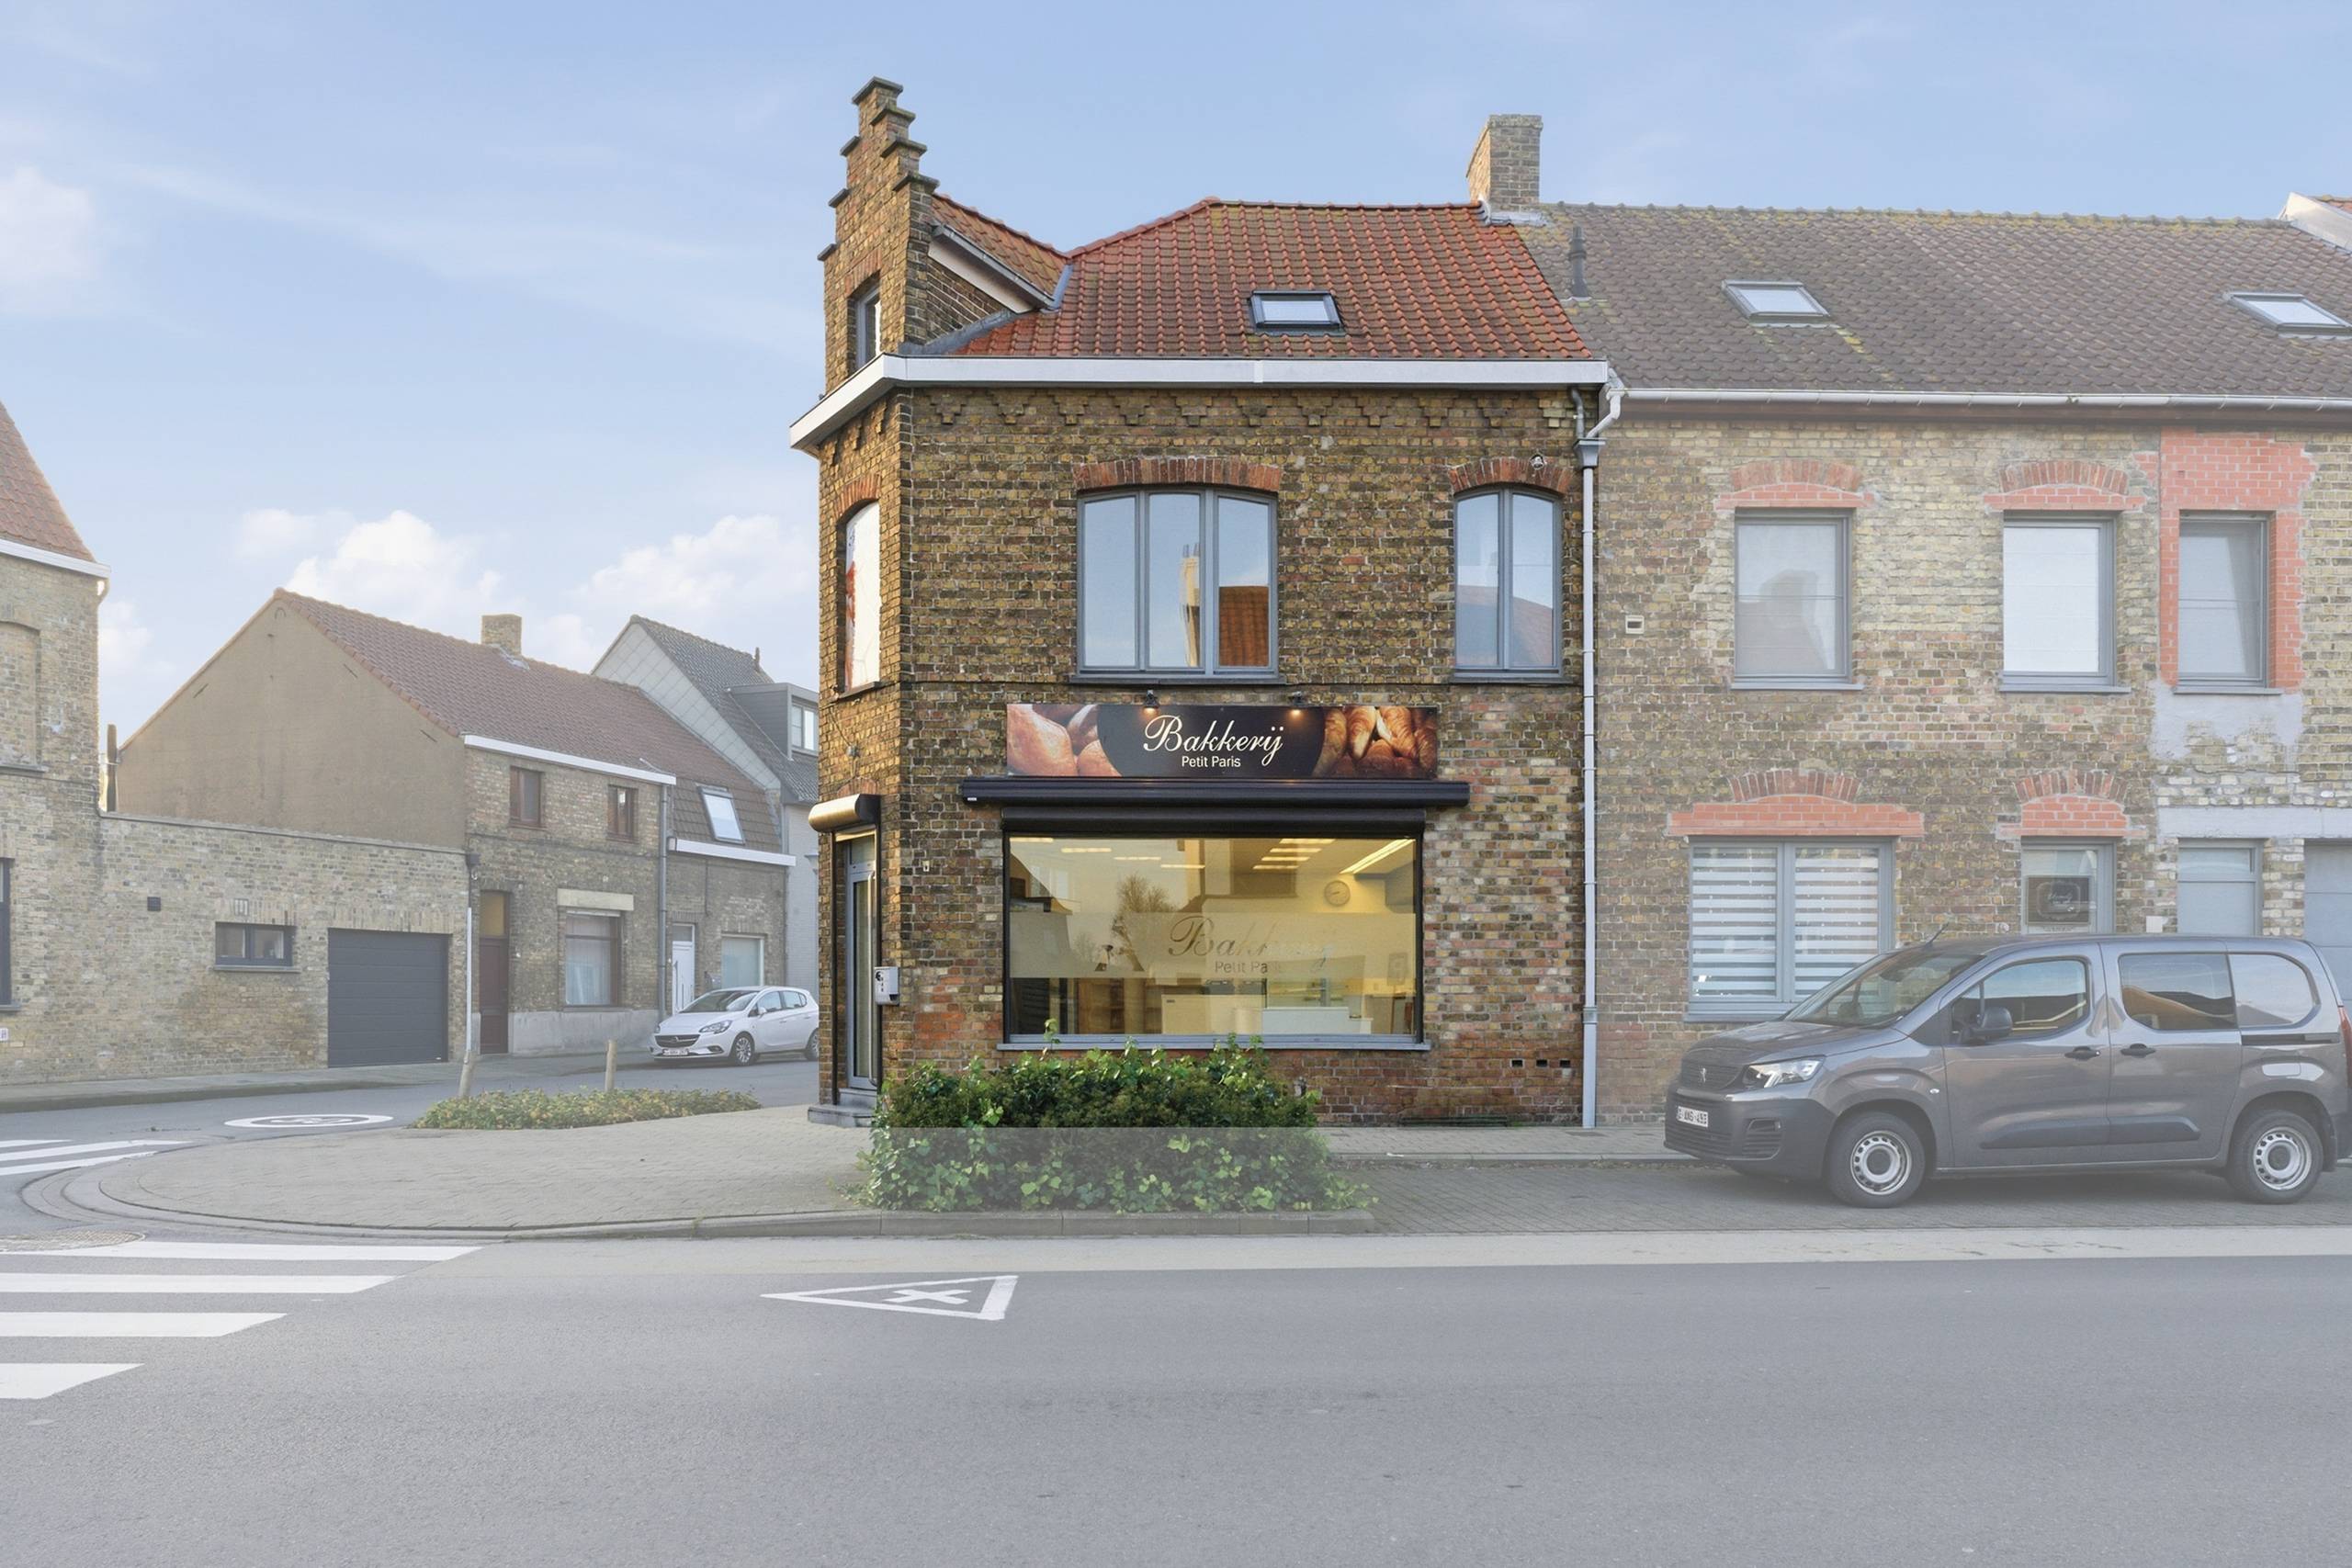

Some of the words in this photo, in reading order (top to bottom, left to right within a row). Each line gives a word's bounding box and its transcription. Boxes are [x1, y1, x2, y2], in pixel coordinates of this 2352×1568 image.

[1143, 715, 1283, 766] Bakkerij
[1182, 755, 1209, 768] Petit
[1212, 755, 1241, 768] Paris
